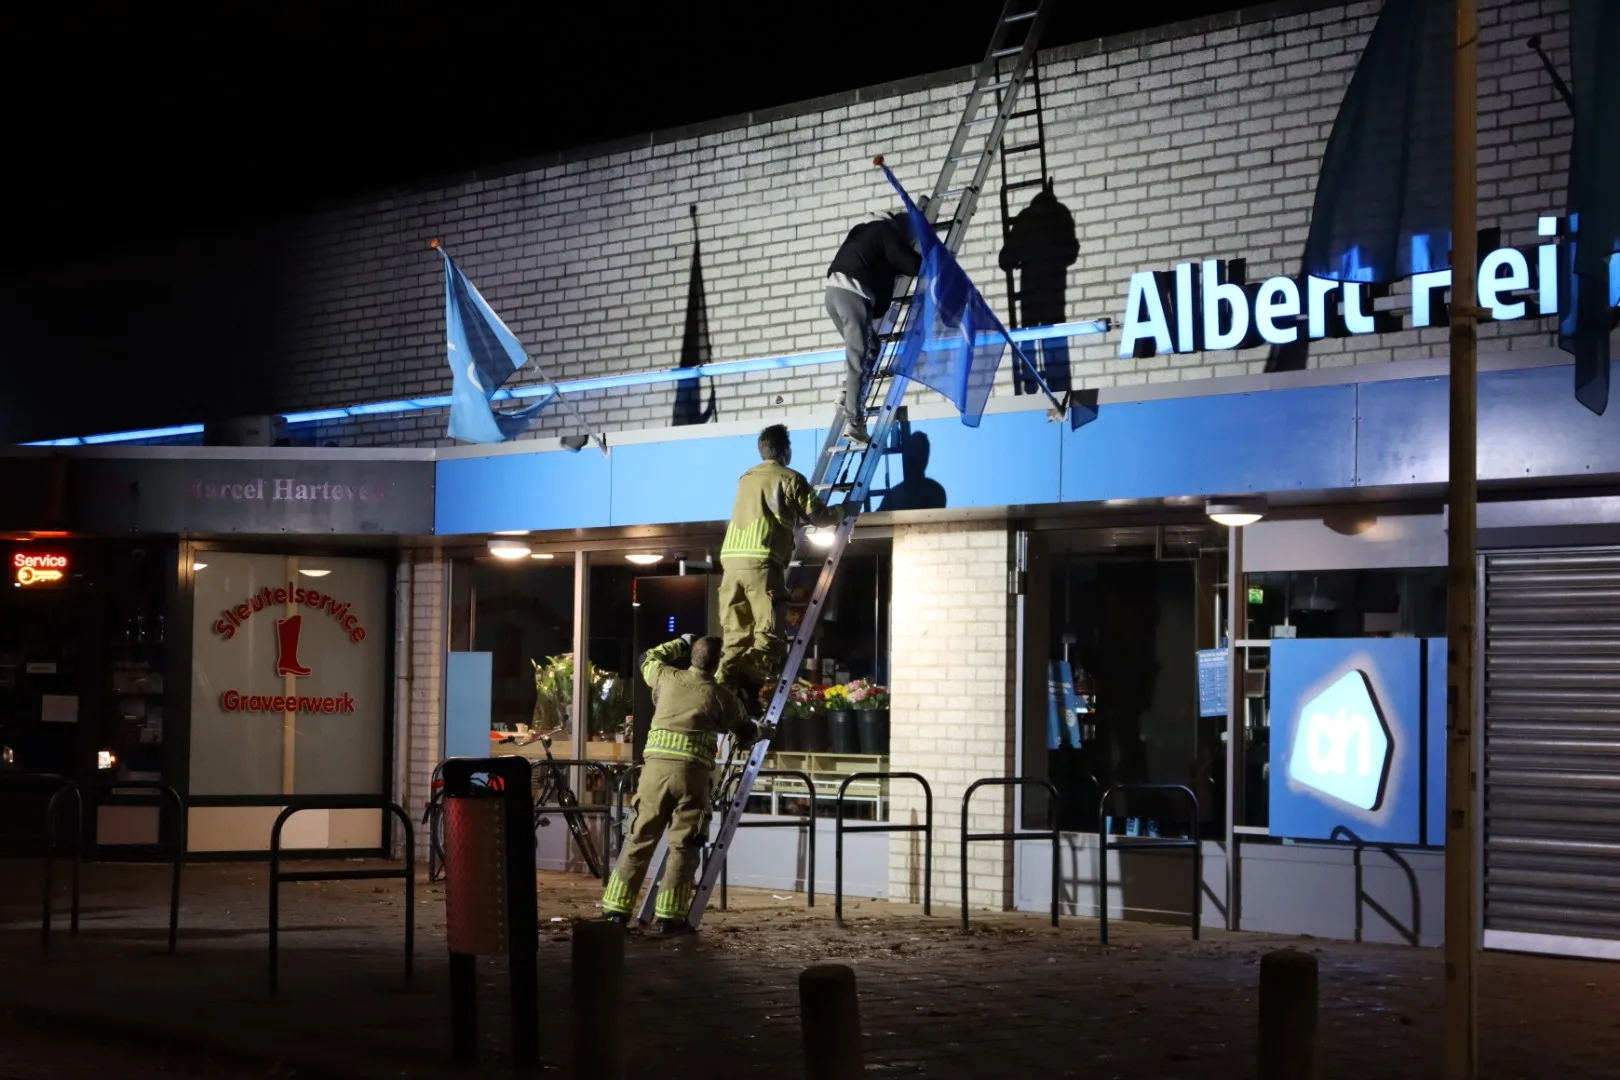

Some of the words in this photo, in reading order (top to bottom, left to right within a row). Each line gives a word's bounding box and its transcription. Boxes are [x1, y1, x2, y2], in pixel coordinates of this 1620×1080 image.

[1119, 246, 1374, 358] Albert
[14, 553, 67, 567] Service
[215, 581, 366, 643] Sleutelservice
[223, 689, 354, 713] Graveerwerk
